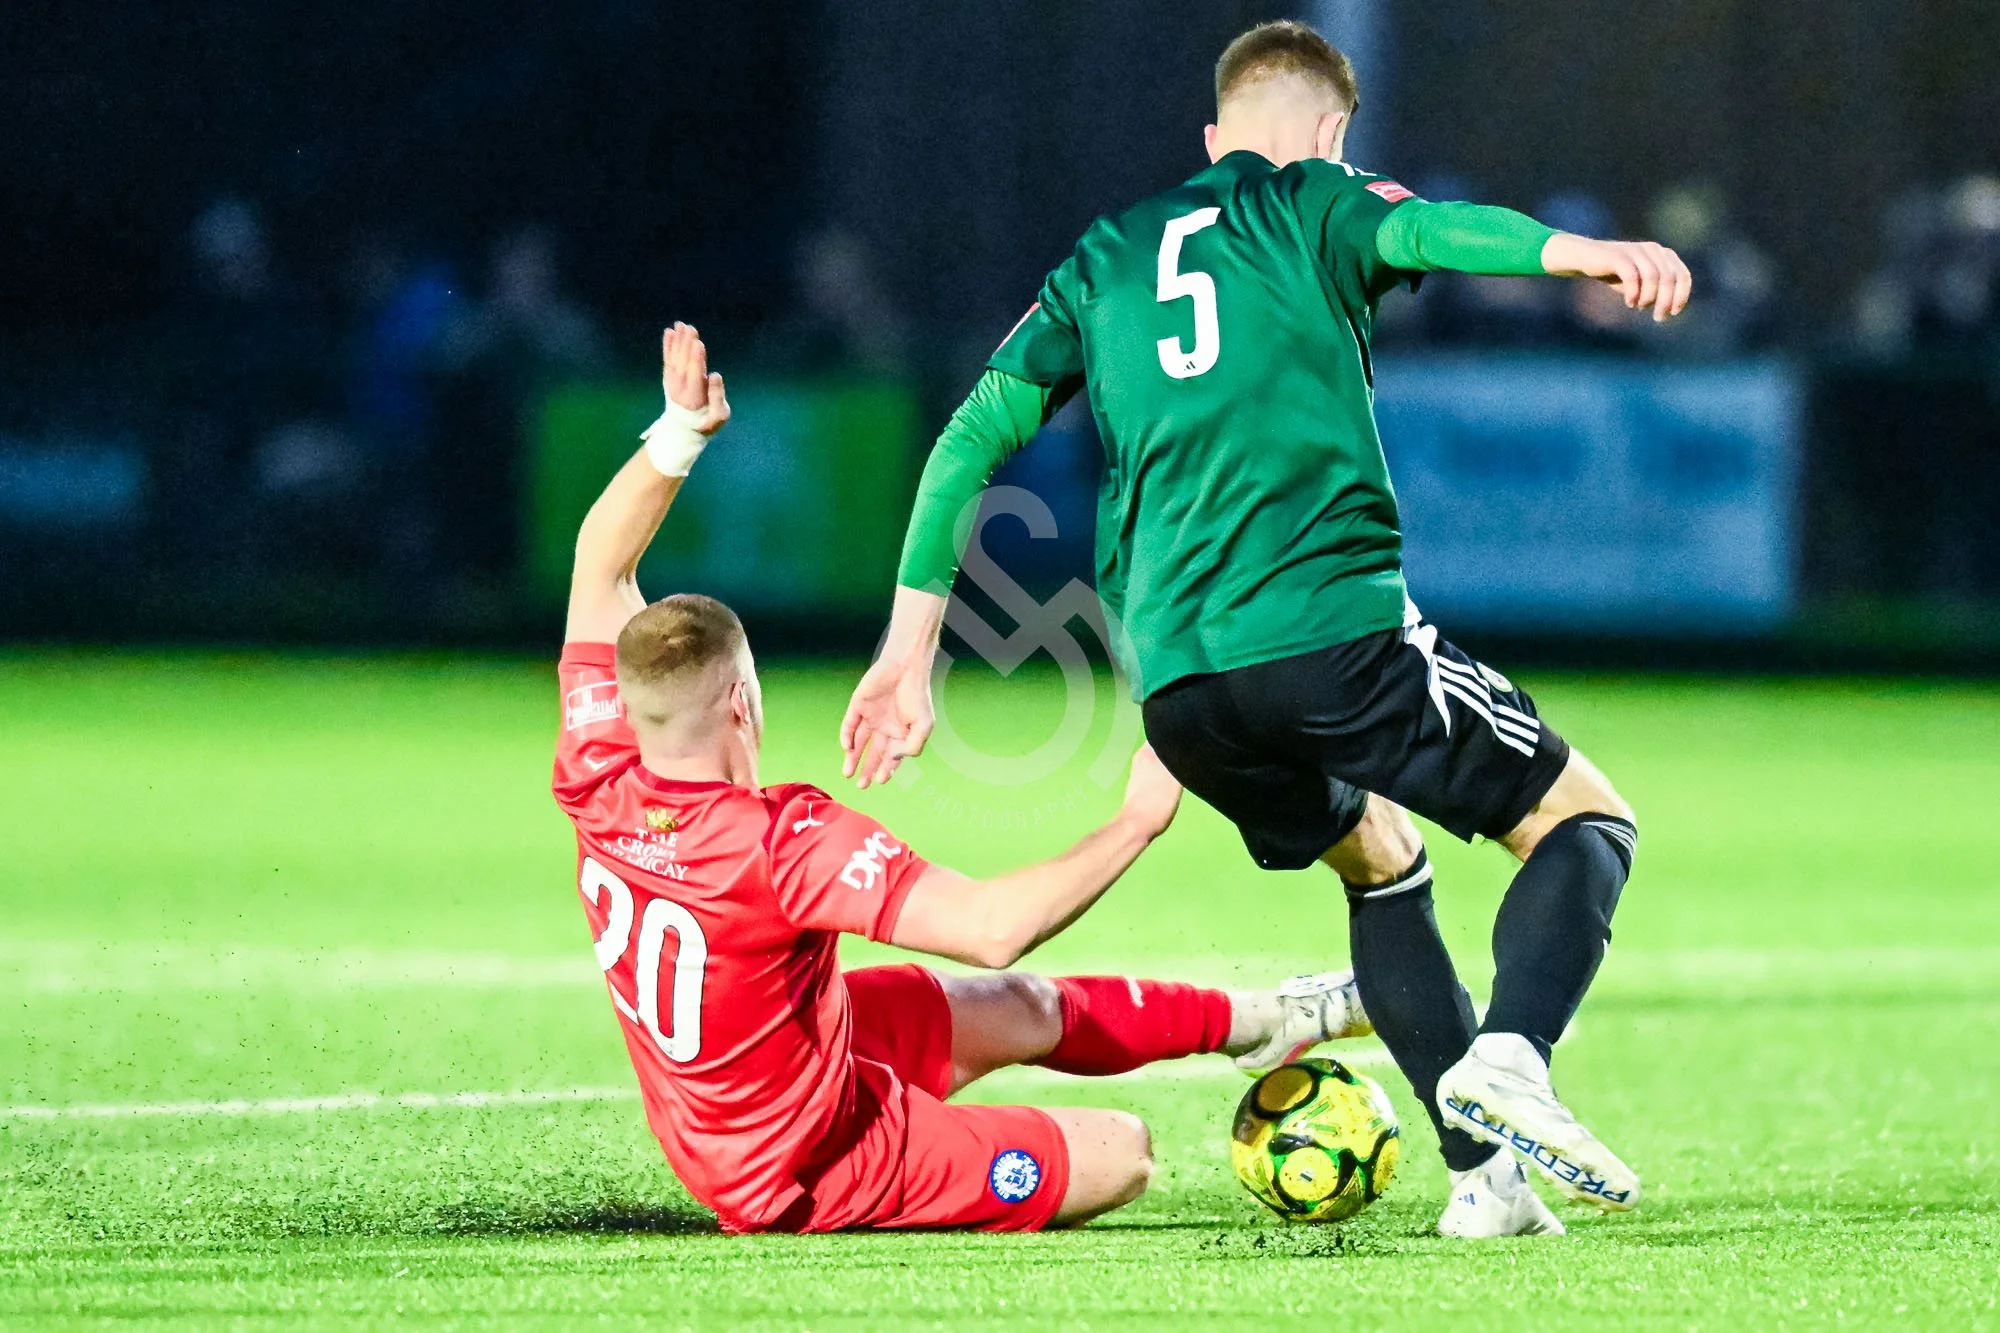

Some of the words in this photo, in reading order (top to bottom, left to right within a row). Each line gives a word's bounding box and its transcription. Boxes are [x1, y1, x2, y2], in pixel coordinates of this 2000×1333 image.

[1156, 206, 1222, 379] 5
[840, 831, 902, 890] DMC
[580, 856, 708, 1063] 20
[1446, 1097, 1630, 1203] PREDATOR
